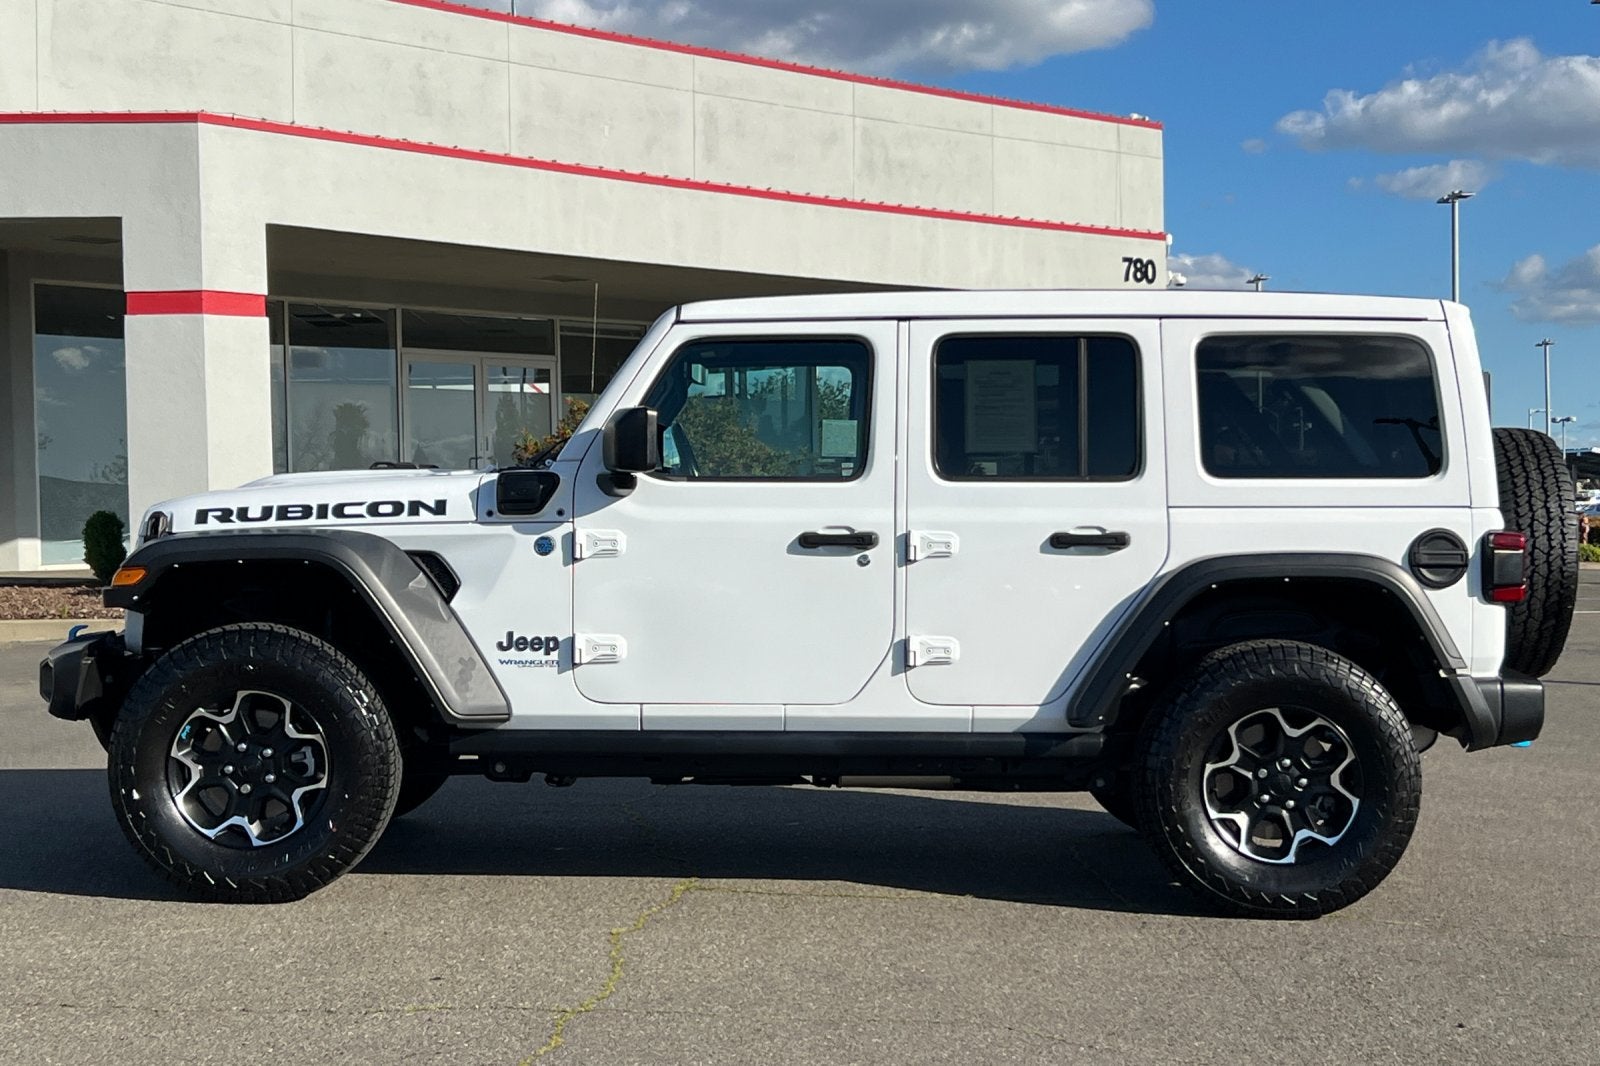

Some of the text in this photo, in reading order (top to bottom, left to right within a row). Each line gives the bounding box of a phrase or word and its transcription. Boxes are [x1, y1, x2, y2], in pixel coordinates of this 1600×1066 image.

[1121, 256, 1157, 285] 780
[194, 498, 448, 525] RUBICON
[496, 630, 560, 656] Jeep
